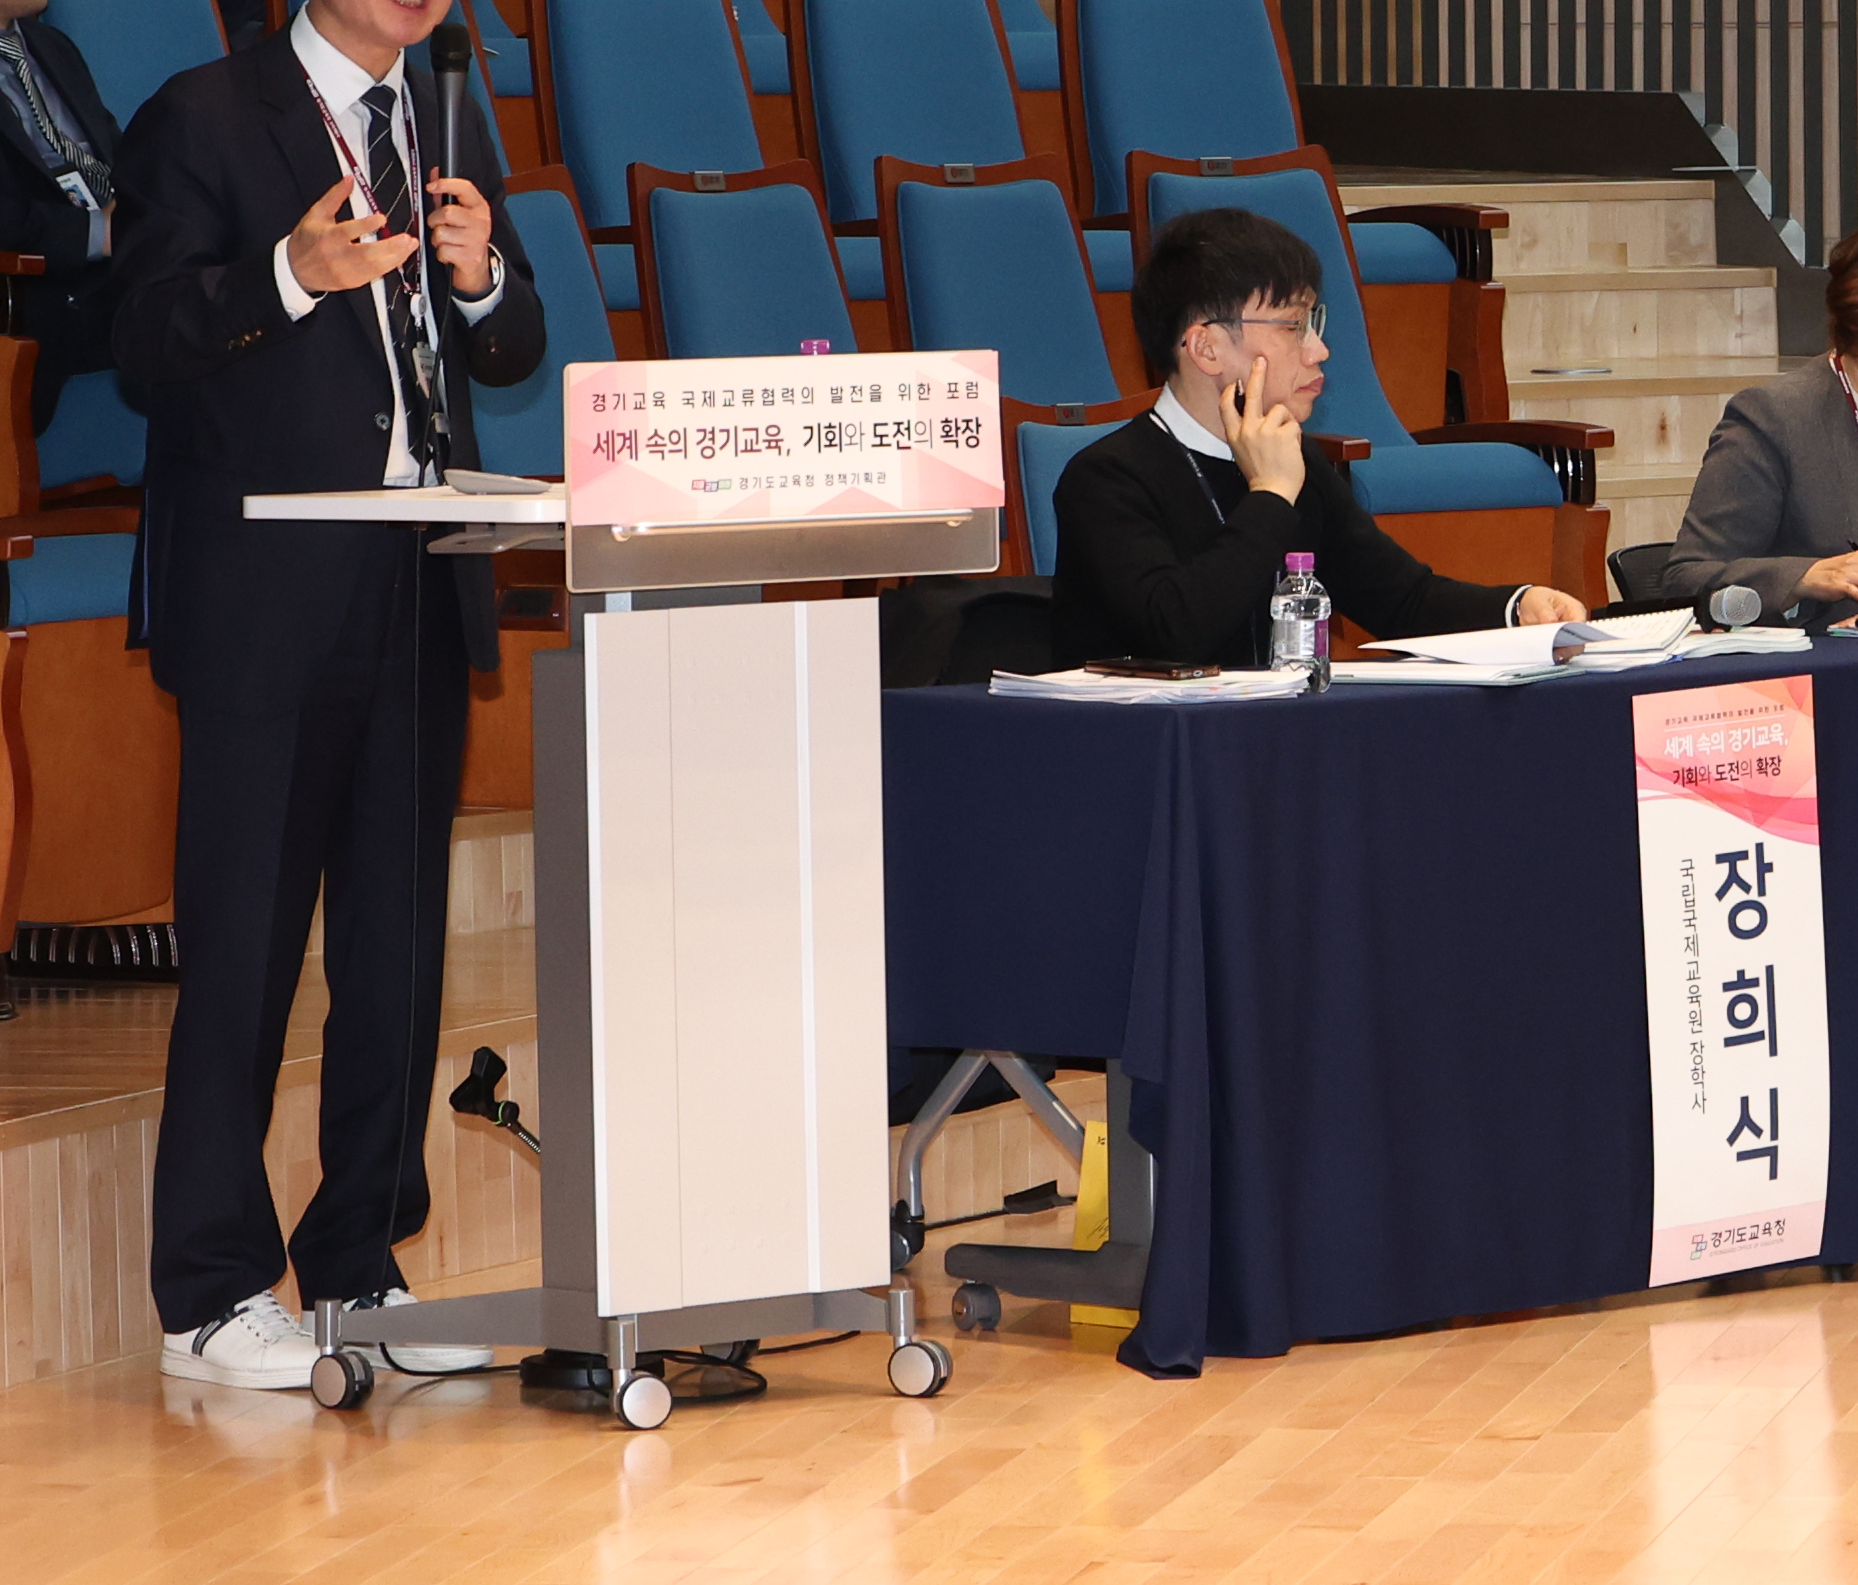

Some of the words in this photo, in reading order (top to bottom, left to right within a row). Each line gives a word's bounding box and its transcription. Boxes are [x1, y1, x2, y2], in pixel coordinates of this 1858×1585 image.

[592, 390, 666, 413] 경기교육
[681, 386, 814, 409] 국제교류협력의
[830, 383, 882, 405] 발전을
[898, 382, 932, 402] 위한
[946, 381, 979, 400] 포럼
[592, 428, 639, 463] 세계
[645, 427, 688, 461] 속의
[695, 424, 791, 460] 경기교육,
[802, 421, 866, 454] 기회와
[870, 418, 933, 451] 도전의
[940, 416, 982, 449] 확장
[739, 474, 815, 491] 경기도교육청
[824, 471, 887, 487] 정책기획관
[1663, 734, 1694, 759] 세계
[1696, 729, 1726, 756] 속의
[1728, 723, 1789, 753] 경기교육,
[1672, 764, 1712, 788] 기회와
[1714, 759, 1753, 782] 도전의
[1755, 754, 1783, 777] 확장
[1679, 858, 1703, 1035] 국립국제교육원
[1714, 841, 1779, 1181] 장희식
[1689, 1039, 1708, 1115] 장학사
[1710, 1218, 1786, 1249] 경기도교육청
